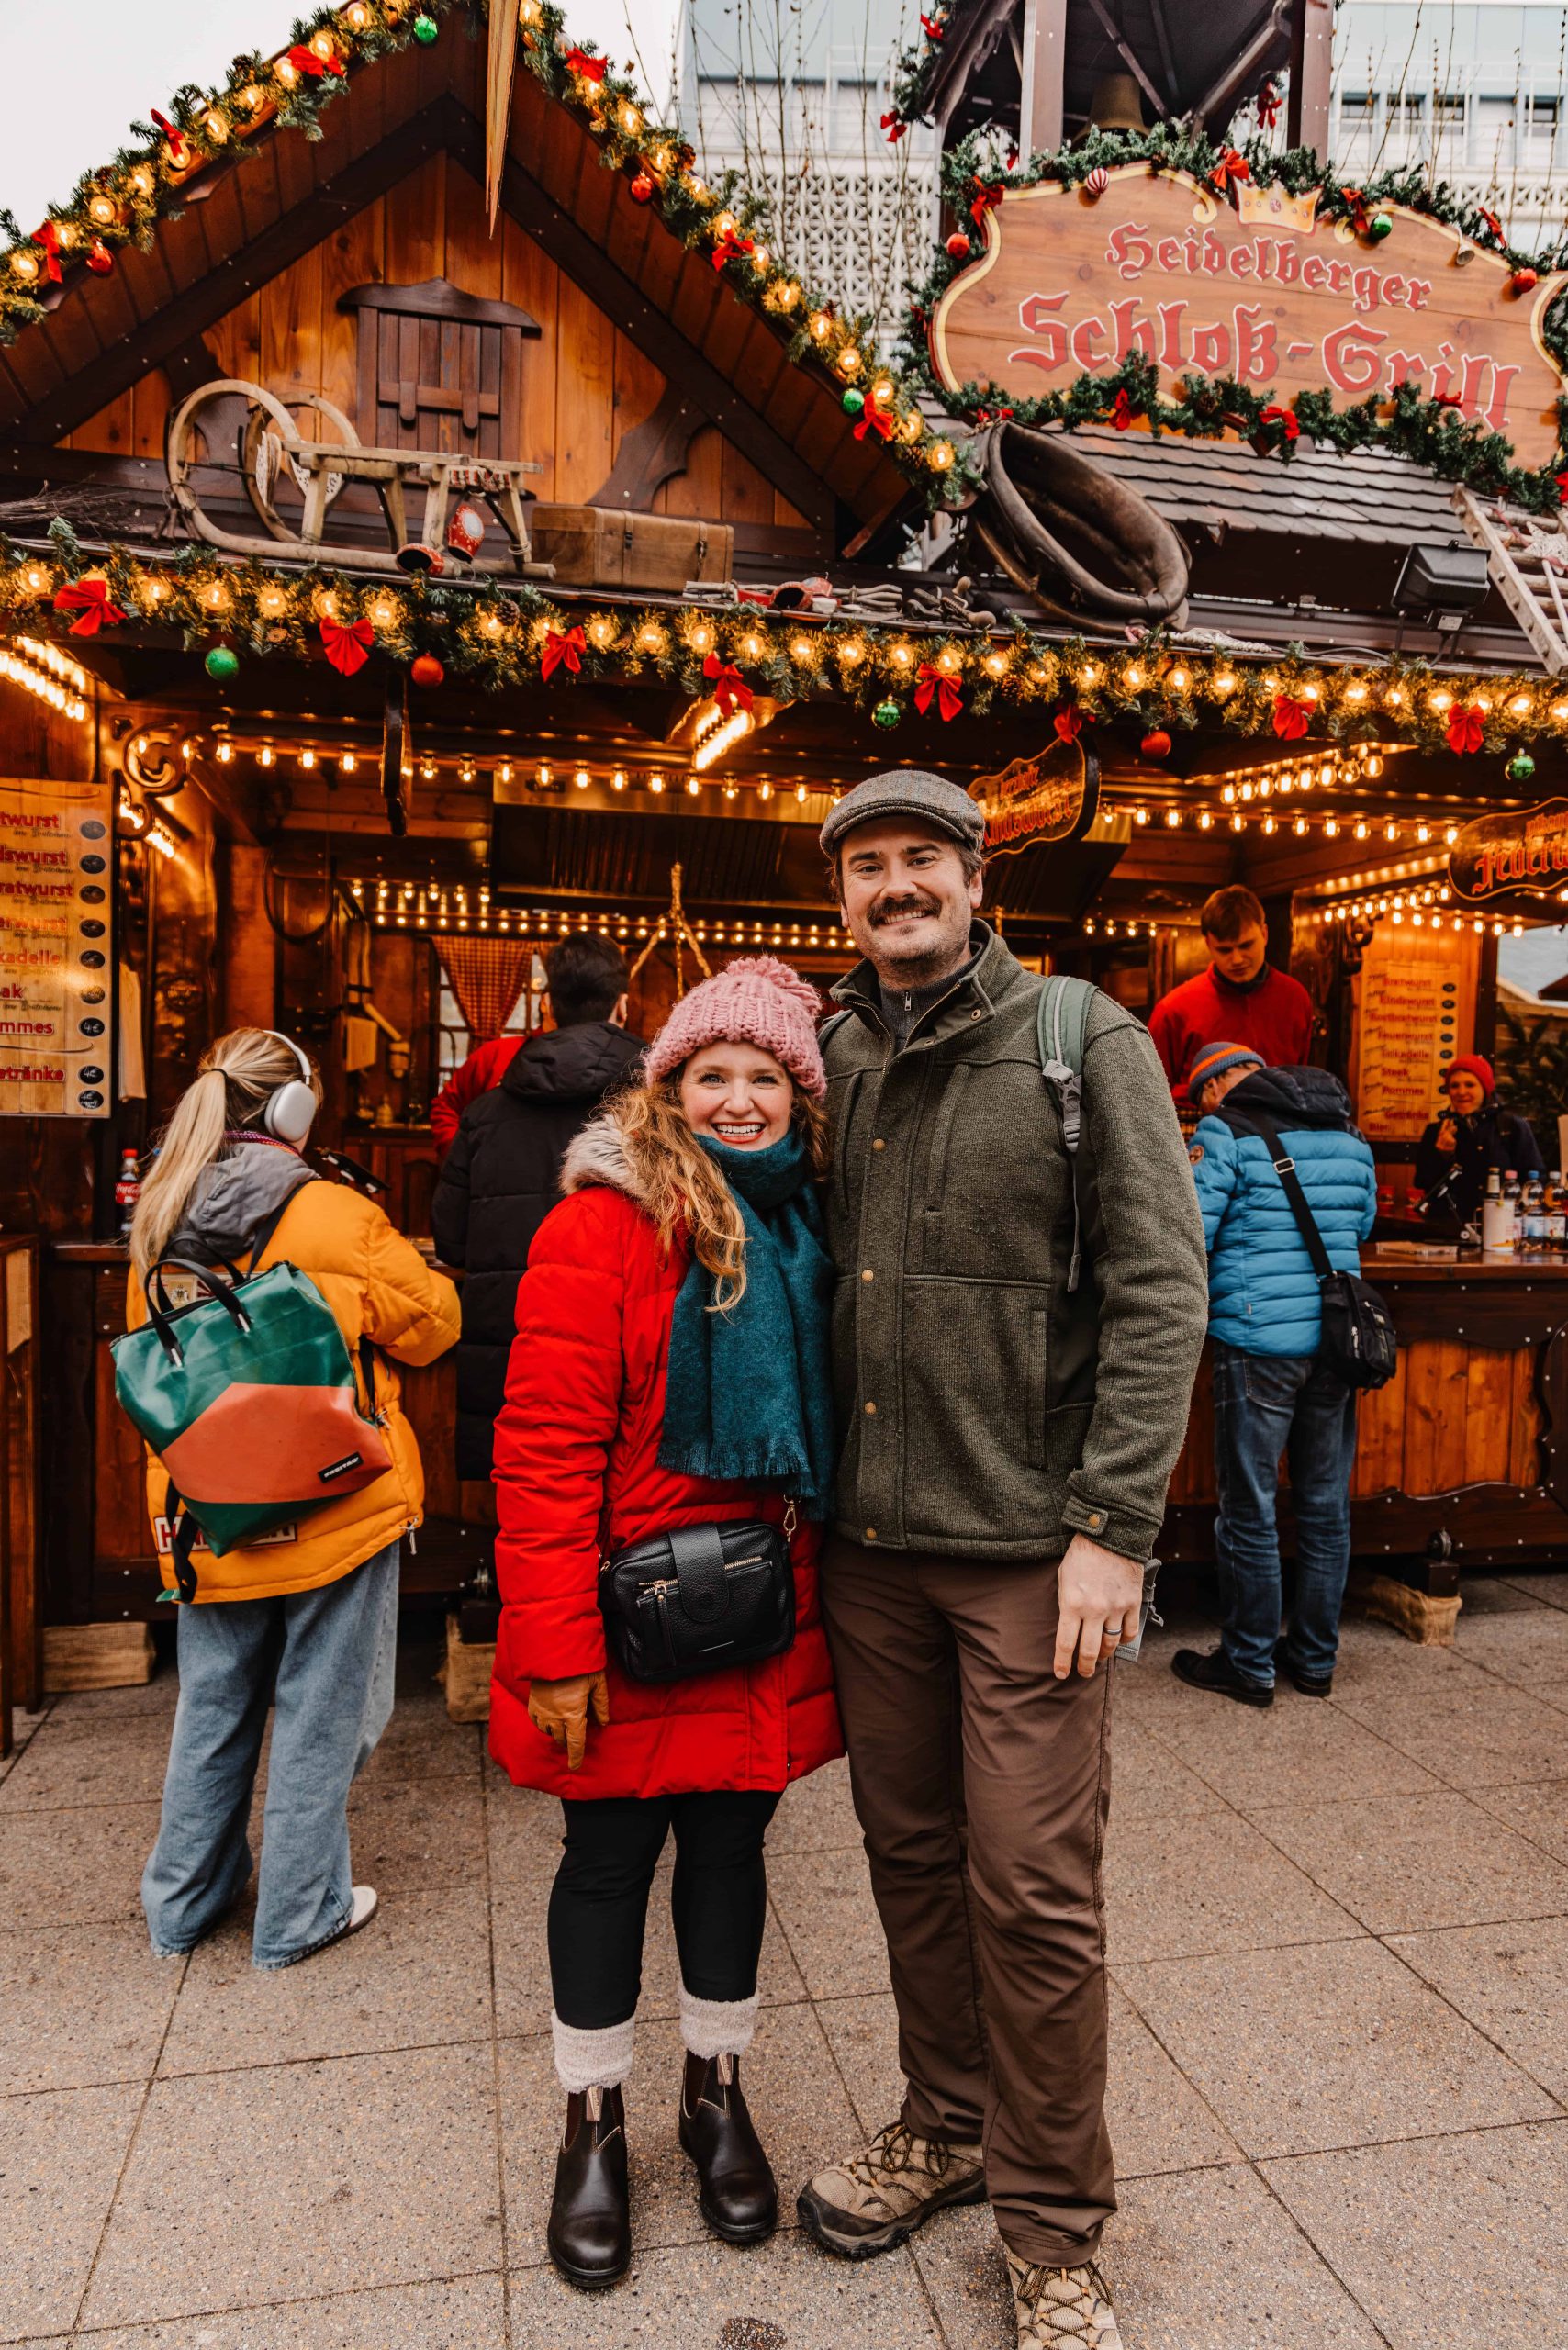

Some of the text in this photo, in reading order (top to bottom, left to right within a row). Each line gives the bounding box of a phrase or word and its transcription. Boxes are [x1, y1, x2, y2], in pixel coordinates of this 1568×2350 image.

[1105, 221, 1432, 312] Heidelberger
[1382, 1086, 1425, 1096] Pommes
[324, 1456, 359, 1478] FREITAG
